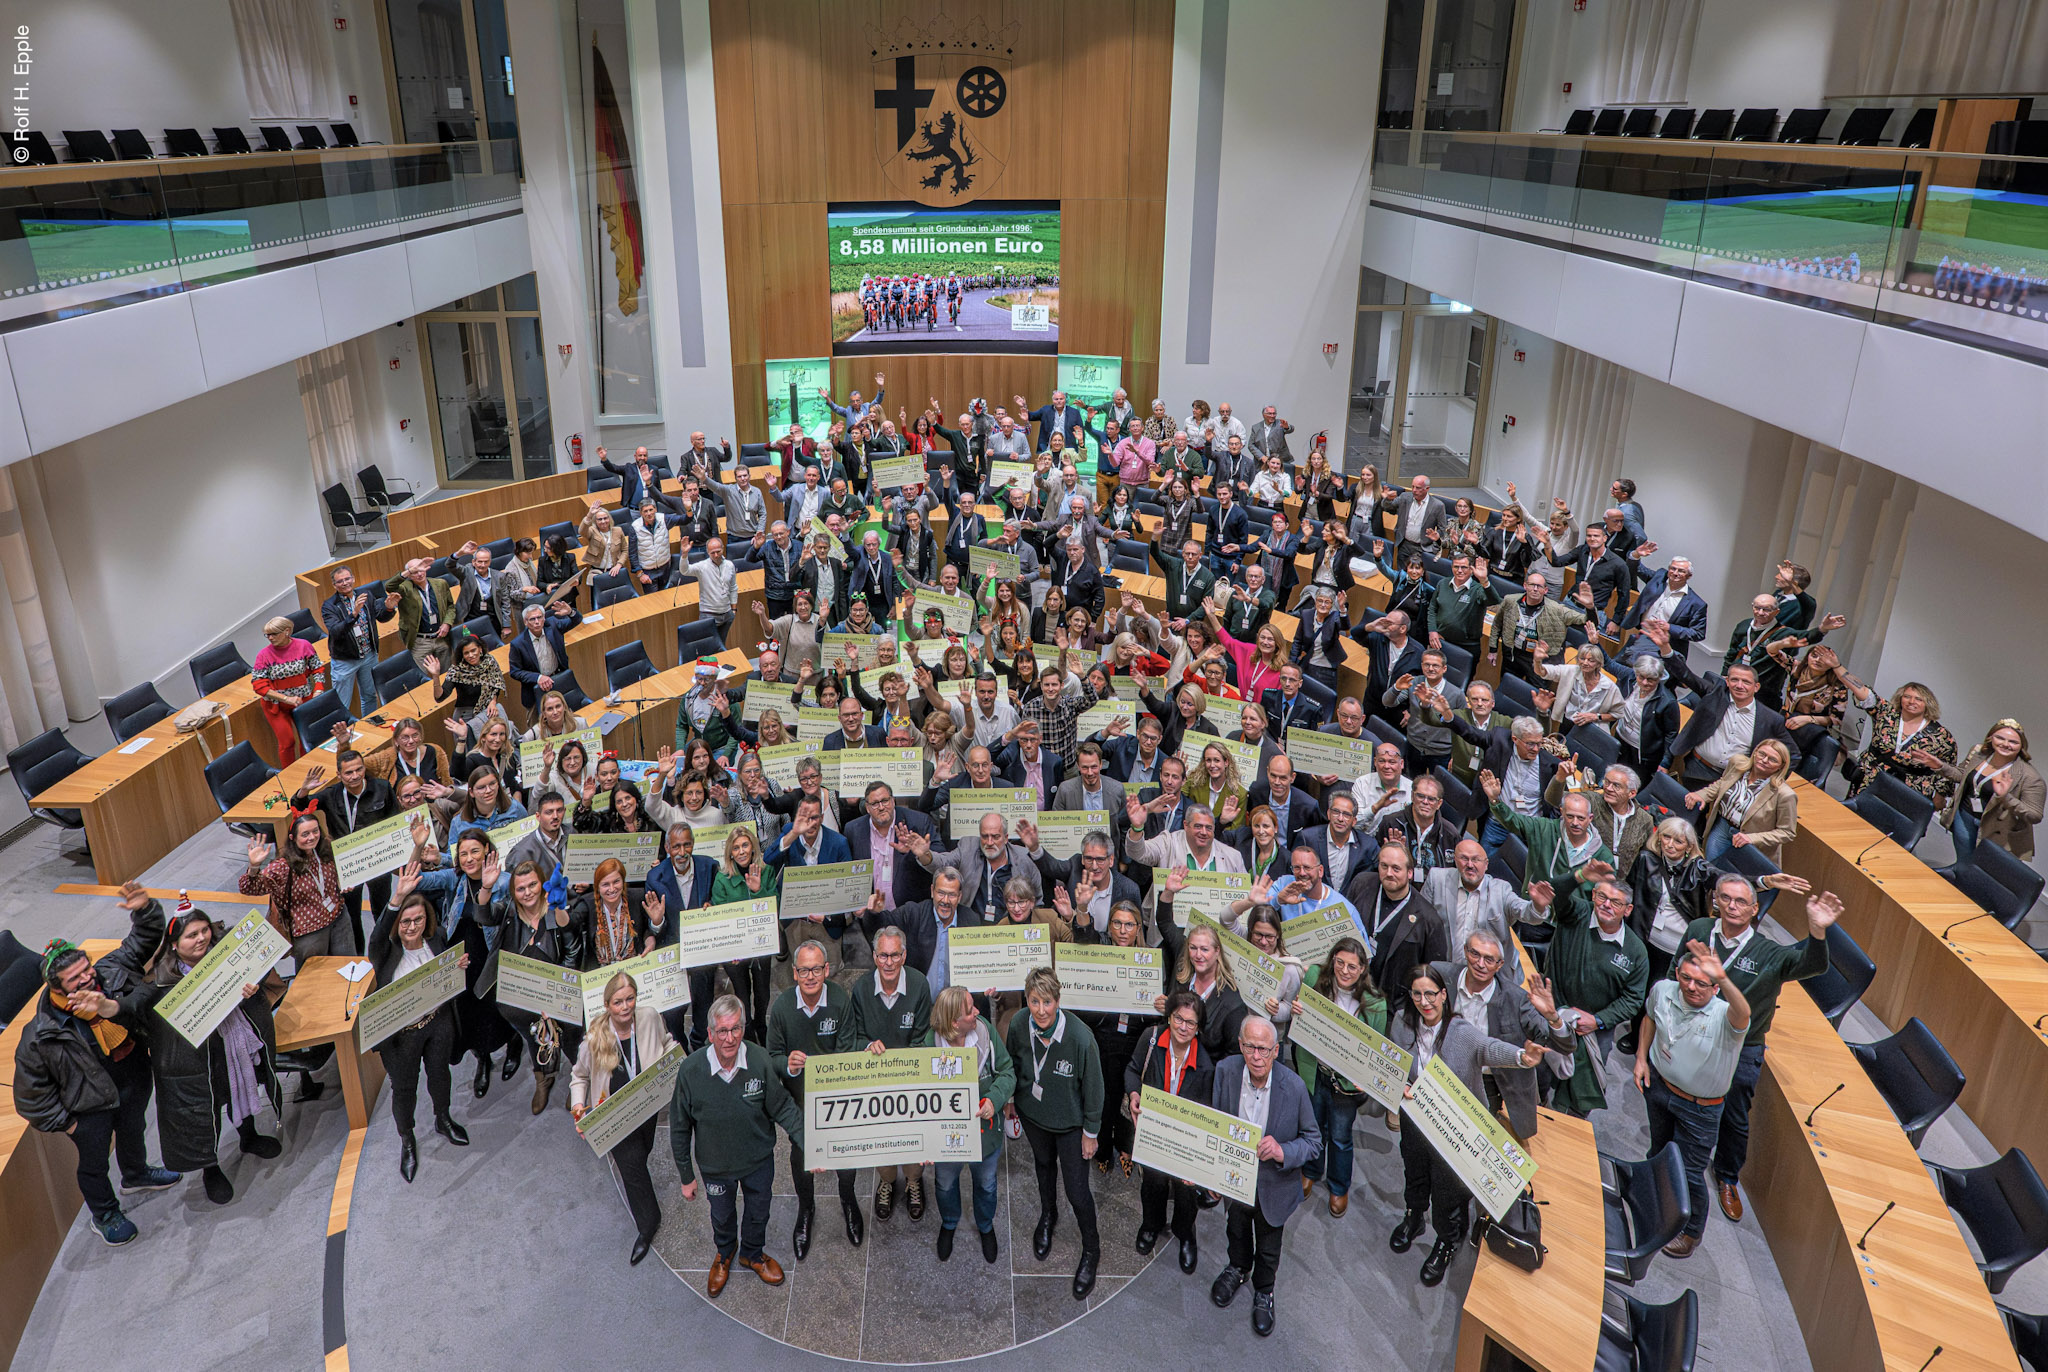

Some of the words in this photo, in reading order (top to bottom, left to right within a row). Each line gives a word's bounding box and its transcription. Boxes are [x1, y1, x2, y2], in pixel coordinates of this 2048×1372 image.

[852, 226, 917, 234] Spendensumme
[920, 224, 934, 232] seit
[936, 224, 976, 233] Gründung
[840, 239, 884, 258] 8,58
[892, 238, 988, 254] Millionen
[994, 237, 1044, 254] Euro
[336, 834, 364, 848] VOR-TOUR
[374, 821, 397, 833] Hoffnung
[491, 828, 514, 838] Hoffnung
[710, 829, 729, 838] Hoffnung
[341, 843, 401, 871] LVR-Irena-Sendler-
[342, 866, 366, 878] Schule,
[368, 849, 404, 868] Euskirchen
[683, 912, 710, 920] VOR-TOUR
[1295, 918, 1318, 928] Hoffnung
[1331, 924, 1348, 933] 5.000
[244, 930, 262, 948] 7.500
[683, 938, 712, 946] Stationäres
[713, 932, 745, 941] Kinderhospiz
[711, 939, 742, 948] Dudenhofen
[1228, 936, 1250, 955] Hoffnung
[1100, 951, 1125, 960] Hoffnung
[162, 979, 194, 1010] VOR-TOUR
[194, 969, 203, 979] der
[203, 944, 229, 969] Hoffnung
[534, 966, 555, 976] Hoffnung
[585, 970, 614, 984] VOR-TOUR
[626, 959, 650, 970] Hoffnung
[660, 966, 677, 976] 7.500
[1252, 969, 1273, 985] 10.000
[187, 998, 220, 1033] Kreisverband
[220, 975, 242, 998] Neuwied
[242, 966, 251, 976] e.V.
[560, 986, 577, 995] 10.000
[182, 1018, 192, 1029] Der
[192, 971, 239, 1018] Kinderschutzbund,
[1304, 991, 1334, 1013] VOR-TOUR
[1335, 1013, 1344, 1021] der
[1345, 1018, 1372, 1041] Hoffnung
[815, 1062, 862, 1073] VOR-TOUR
[865, 1060, 878, 1069] der
[880, 1057, 919, 1068] Hoffnung
[1376, 1056, 1398, 1076] 10.000
[825, 1074, 869, 1083] Benefiz-Radtour
[614, 1094, 623, 1102] der
[624, 1074, 650, 1094] Hoffnung
[823, 1093, 941, 1121] 777.000,00
[949, 1092, 962, 1113] €
[1433, 1062, 1461, 1095] VOR-TOUR
[1460, 1095, 1470, 1105] der
[1470, 1105, 1496, 1136] Hoffnung
[1145, 1093, 1178, 1111] VOR-TOUR
[1179, 1106, 1189, 1115] der
[1190, 1110, 1219, 1128] Hoffnung
[1410, 1092, 1425, 1109] Bad
[1424, 1108, 1460, 1152] Kreuznach
[1417, 1085, 1479, 1157] Kinderschutzbund
[832, 1143, 873, 1153] Begünstigte
[874, 1140, 919, 1148] Institutionen
[1224, 1144, 1250, 1160] 20.000
[1494, 1156, 1513, 1179] 7.500
